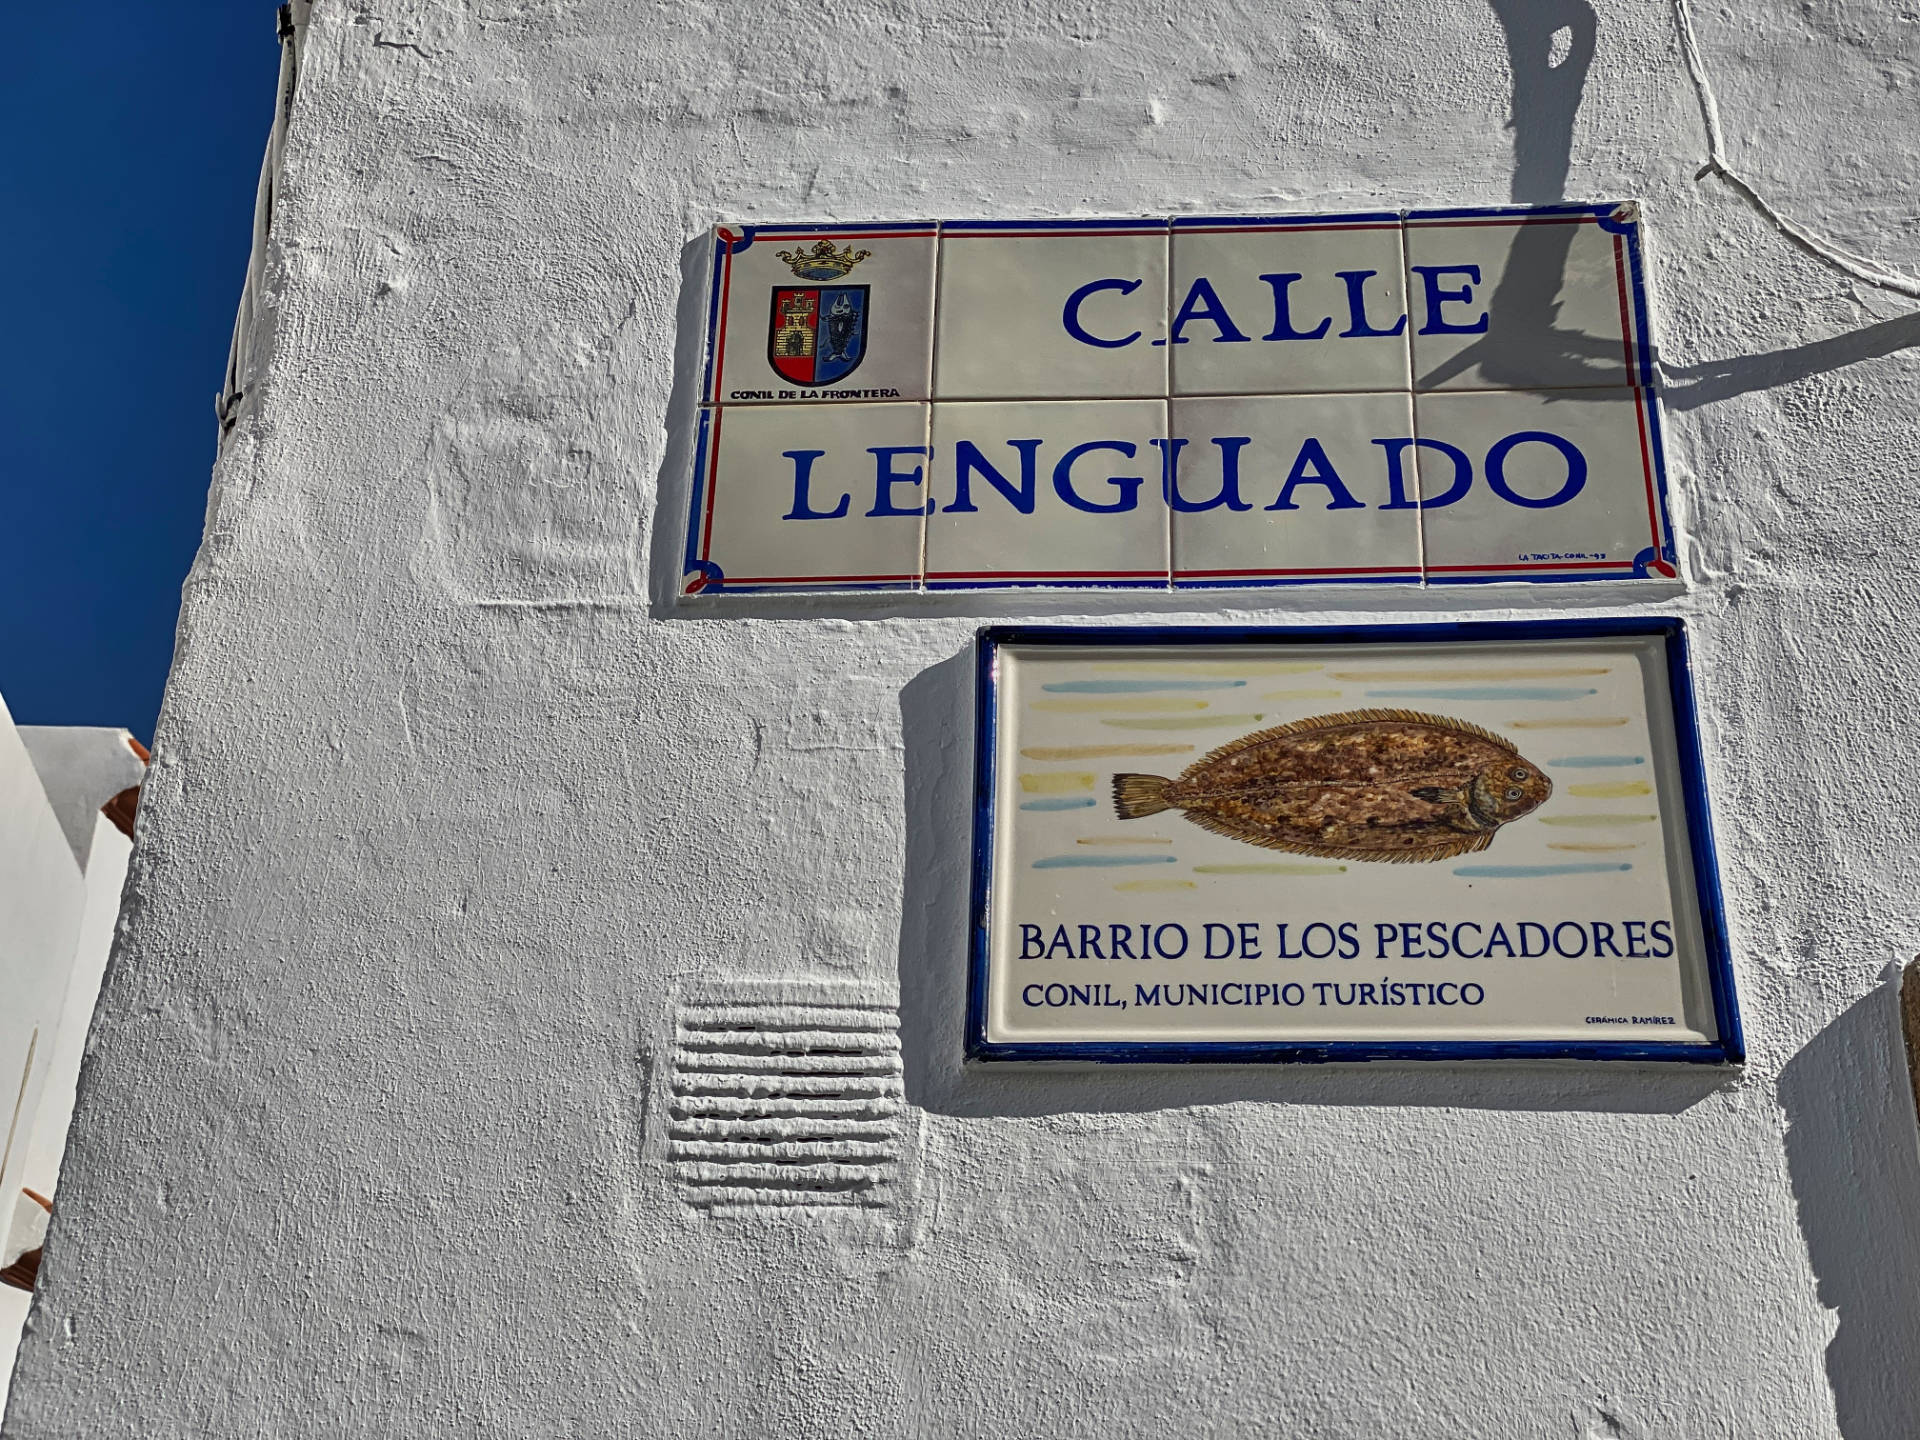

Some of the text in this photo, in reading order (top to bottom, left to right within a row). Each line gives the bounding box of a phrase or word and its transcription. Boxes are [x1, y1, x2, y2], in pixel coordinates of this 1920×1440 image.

[1062, 264, 1489, 348] CALLE
[730, 388, 900, 400] CONIL DE LA FRONTERA
[781, 430, 1588, 521] LENGUADO
[1518, 553, 1529, 561] LA
[1018, 920, 1674, 960] BARRIO DE LOS PESCADORES
[1022, 976, 1485, 1010] CONIL, MUNICIPIO TURÍSTICO
[1585, 1016, 1676, 1025] CERÁMICA RAMÍREZ
